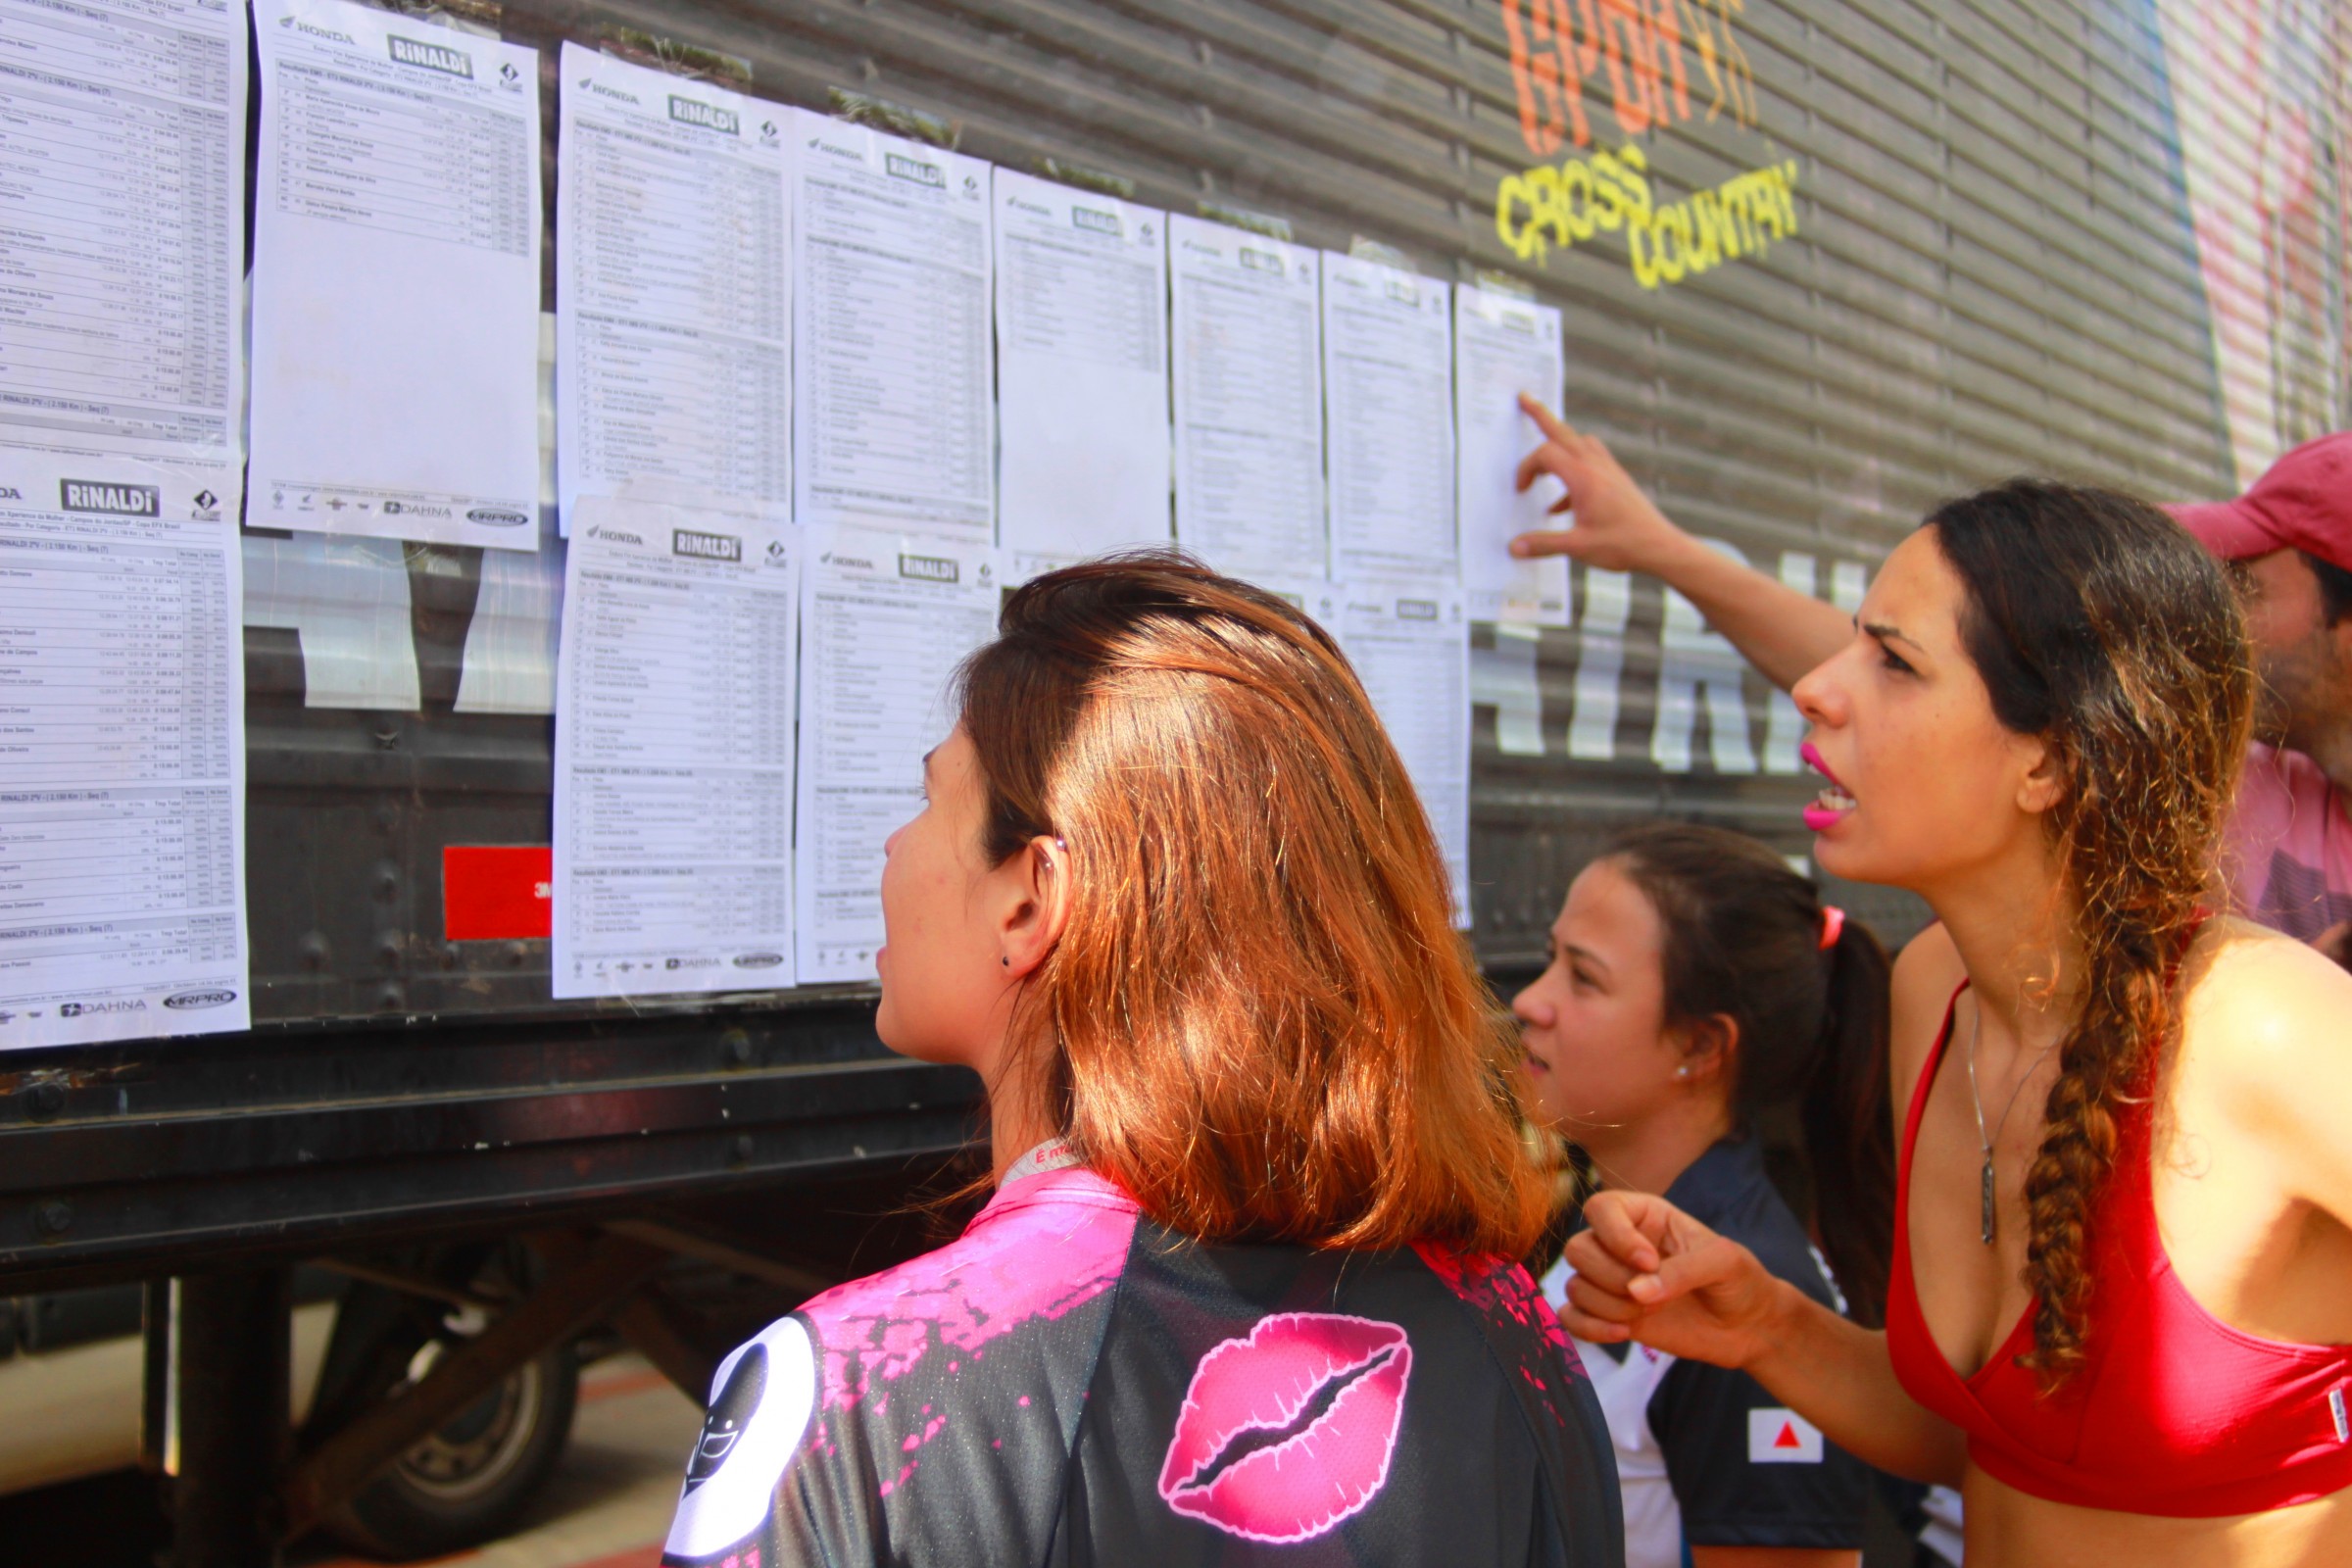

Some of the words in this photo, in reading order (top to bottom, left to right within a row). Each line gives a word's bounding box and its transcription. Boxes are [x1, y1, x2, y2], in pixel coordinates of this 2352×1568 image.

[297, 22, 356, 45] HONDA
[592, 83, 642, 106] HONDA
[820, 142, 863, 162] HONDA
[1496, 142, 1652, 263] CROSS
[1628, 157, 1796, 290] COUNTRY
[399, 504, 453, 518] DAHNA
[599, 530, 644, 547] HONDA
[831, 556, 874, 570] HONDA
[81, 1000, 148, 1015] DAHNA
[167, 990, 234, 1007] MRPRO
